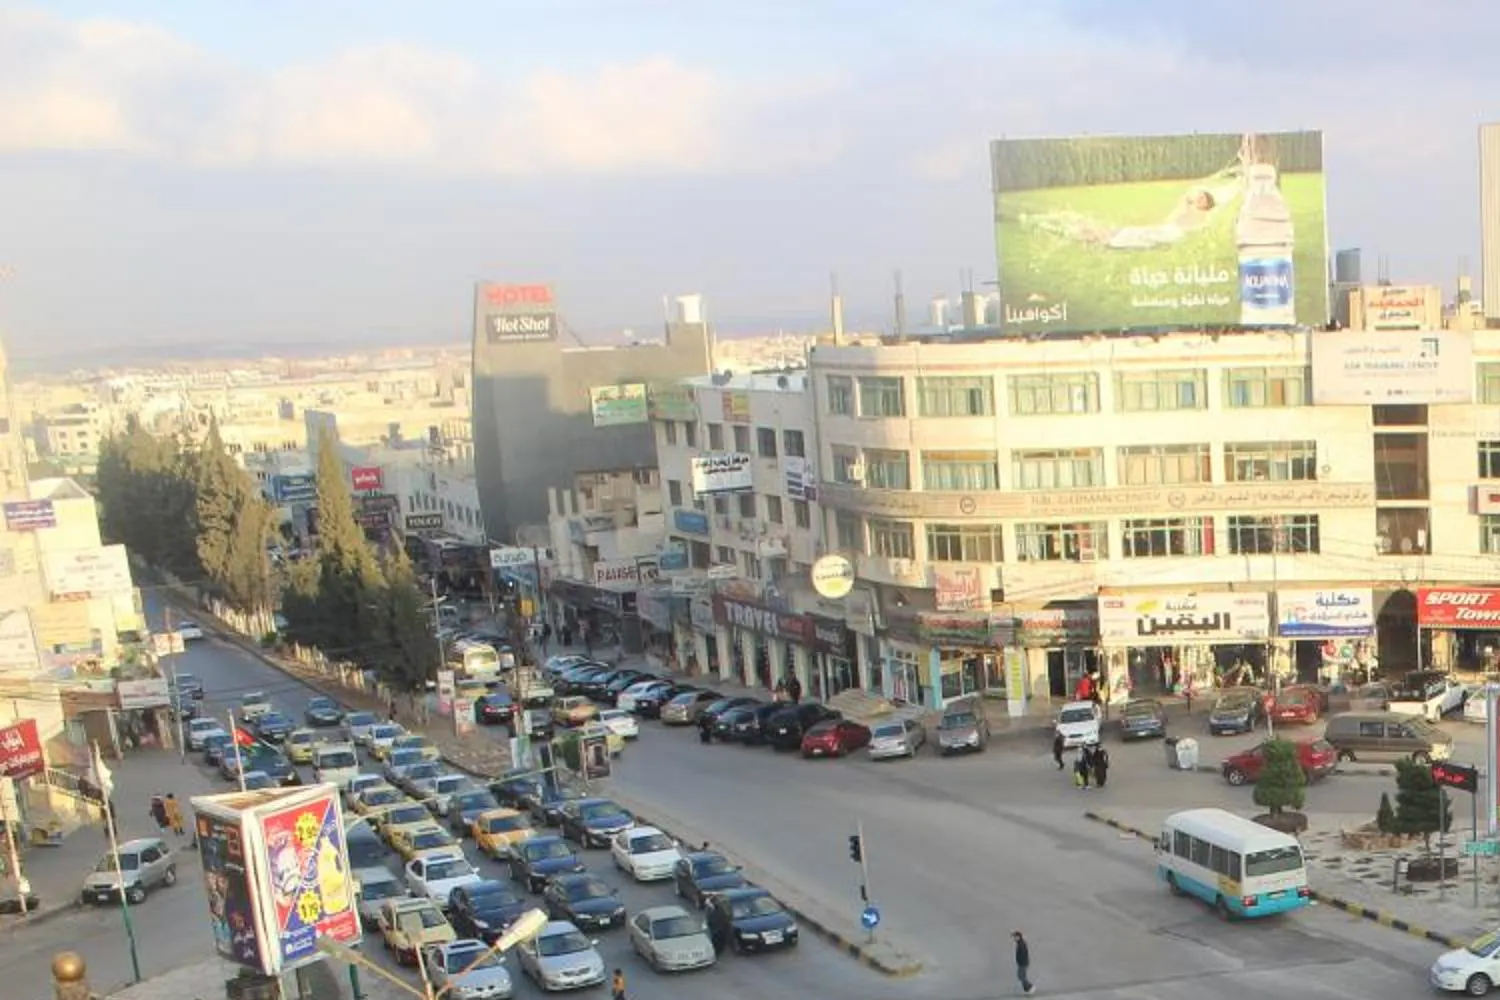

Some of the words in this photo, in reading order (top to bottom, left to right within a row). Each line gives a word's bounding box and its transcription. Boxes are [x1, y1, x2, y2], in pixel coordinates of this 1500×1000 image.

[487, 285, 552, 304] HOTEL
[1426, 591, 1494, 605] SPORT
[724, 602, 779, 636] TRAVEL
[1136, 612, 1231, 637] اليقين
